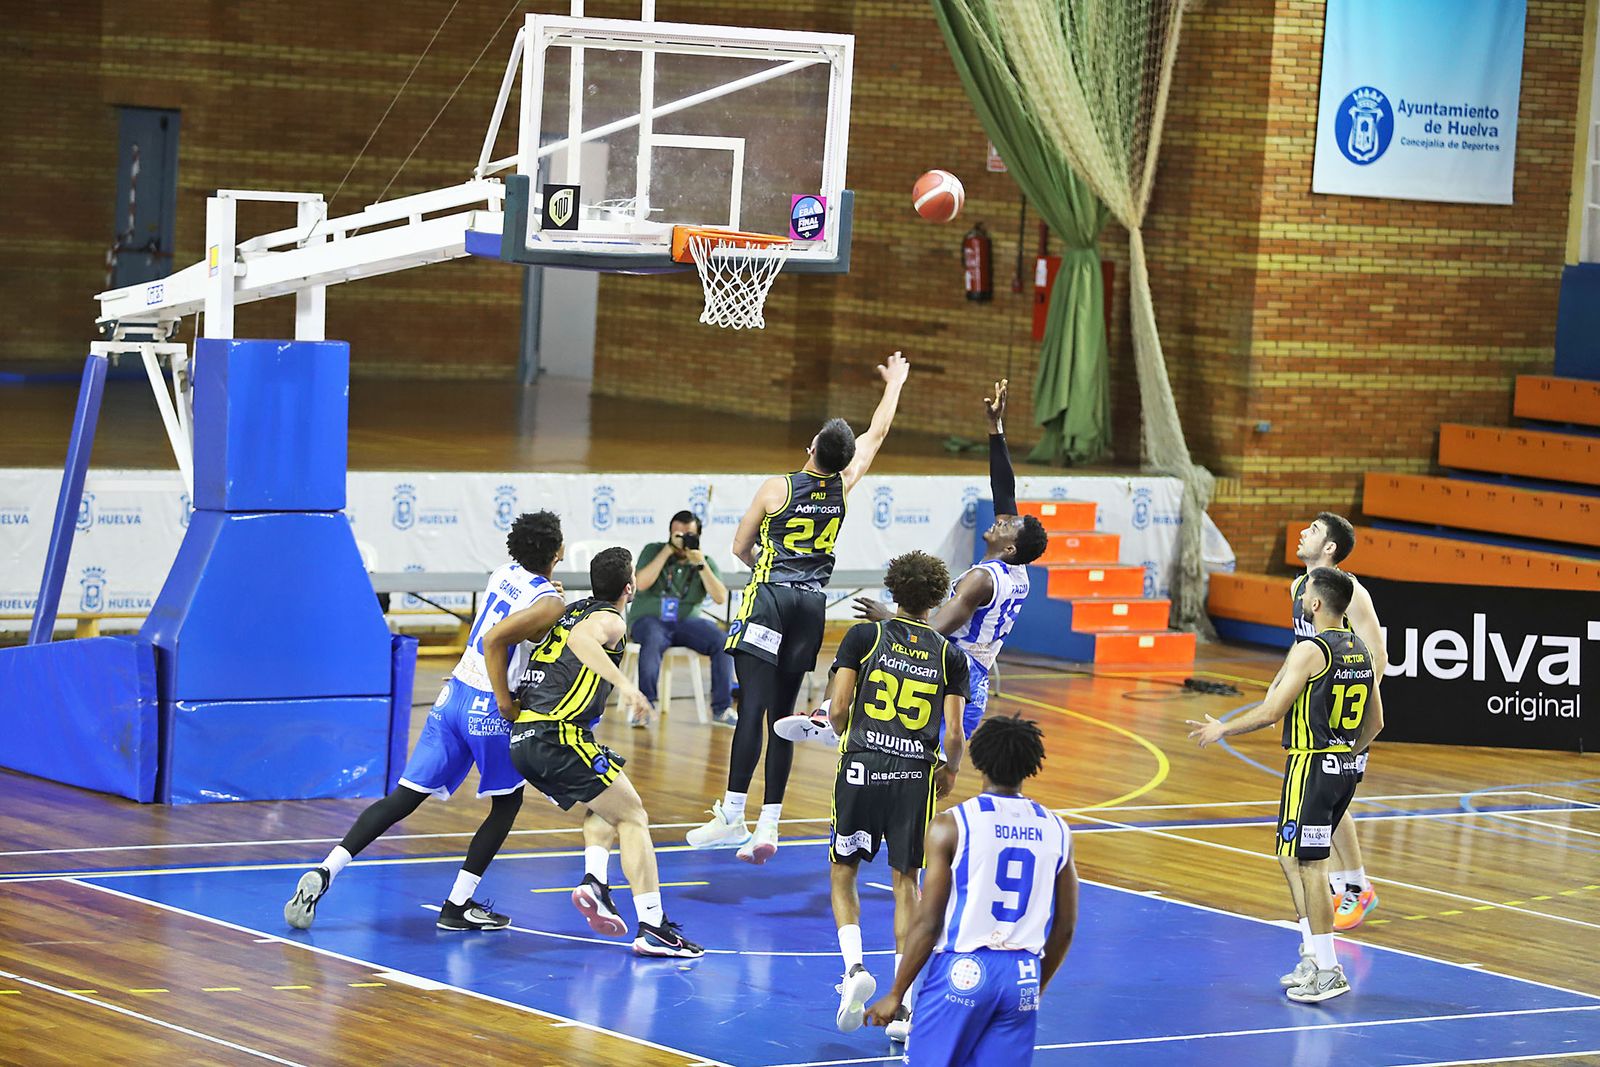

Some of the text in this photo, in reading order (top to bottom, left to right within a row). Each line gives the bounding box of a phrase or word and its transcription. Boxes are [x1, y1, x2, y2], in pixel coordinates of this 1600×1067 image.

[1398, 99, 1499, 119] Ayuntamiento
[1424, 120, 1498, 137] de Huelva
[1448, 140, 1459, 149] de
[1462, 141, 1500, 152] Deportes
[554, 197, 569, 219] 100
[799, 217, 819, 228] FINAL
[811, 492, 826, 500] PAU
[795, 504, 840, 514] Adrihosan
[0, 514, 29, 525] ELVA
[98, 514, 142, 525] HUELVA
[419, 515, 458, 524] HUELVA
[616, 514, 655, 524] HUELVA
[712, 515, 742, 524] HUEL
[783, 517, 840, 554] 24
[500, 579, 522, 600] GAINES
[108, 599, 152, 609] HUELVA
[891, 642, 929, 660] KELVYN
[1381, 613, 1581, 685] uelva
[879, 653, 938, 679] Adrihosan
[1341, 655, 1365, 664] VICTOR
[1333, 668, 1373, 680] Adrihosan
[863, 669, 939, 730] 35
[1328, 683, 1368, 730] 13
[1487, 690, 1581, 721] original
[994, 824, 1043, 841] BOAHEN
[991, 847, 1036, 923] 9
